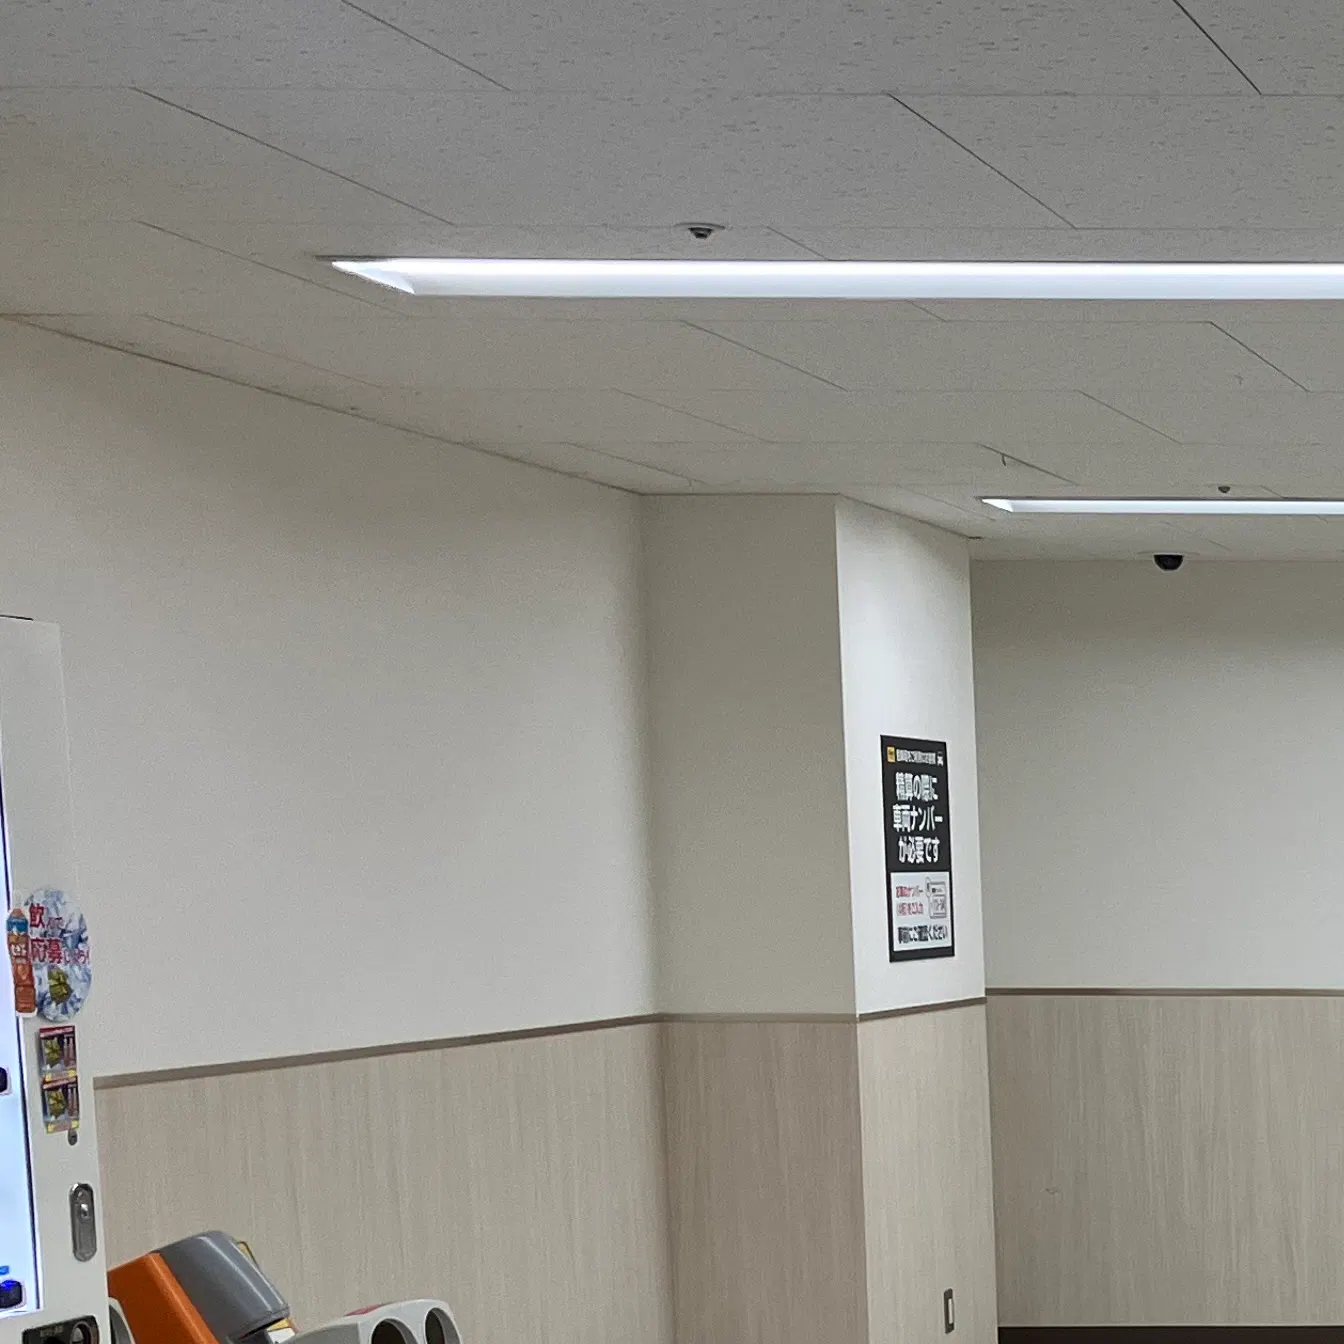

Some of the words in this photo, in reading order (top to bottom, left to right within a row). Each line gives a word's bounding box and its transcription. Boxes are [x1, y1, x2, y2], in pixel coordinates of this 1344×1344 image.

[892, 804, 943, 832] 車両ナンバー
[898, 836, 941, 864] が必要です
